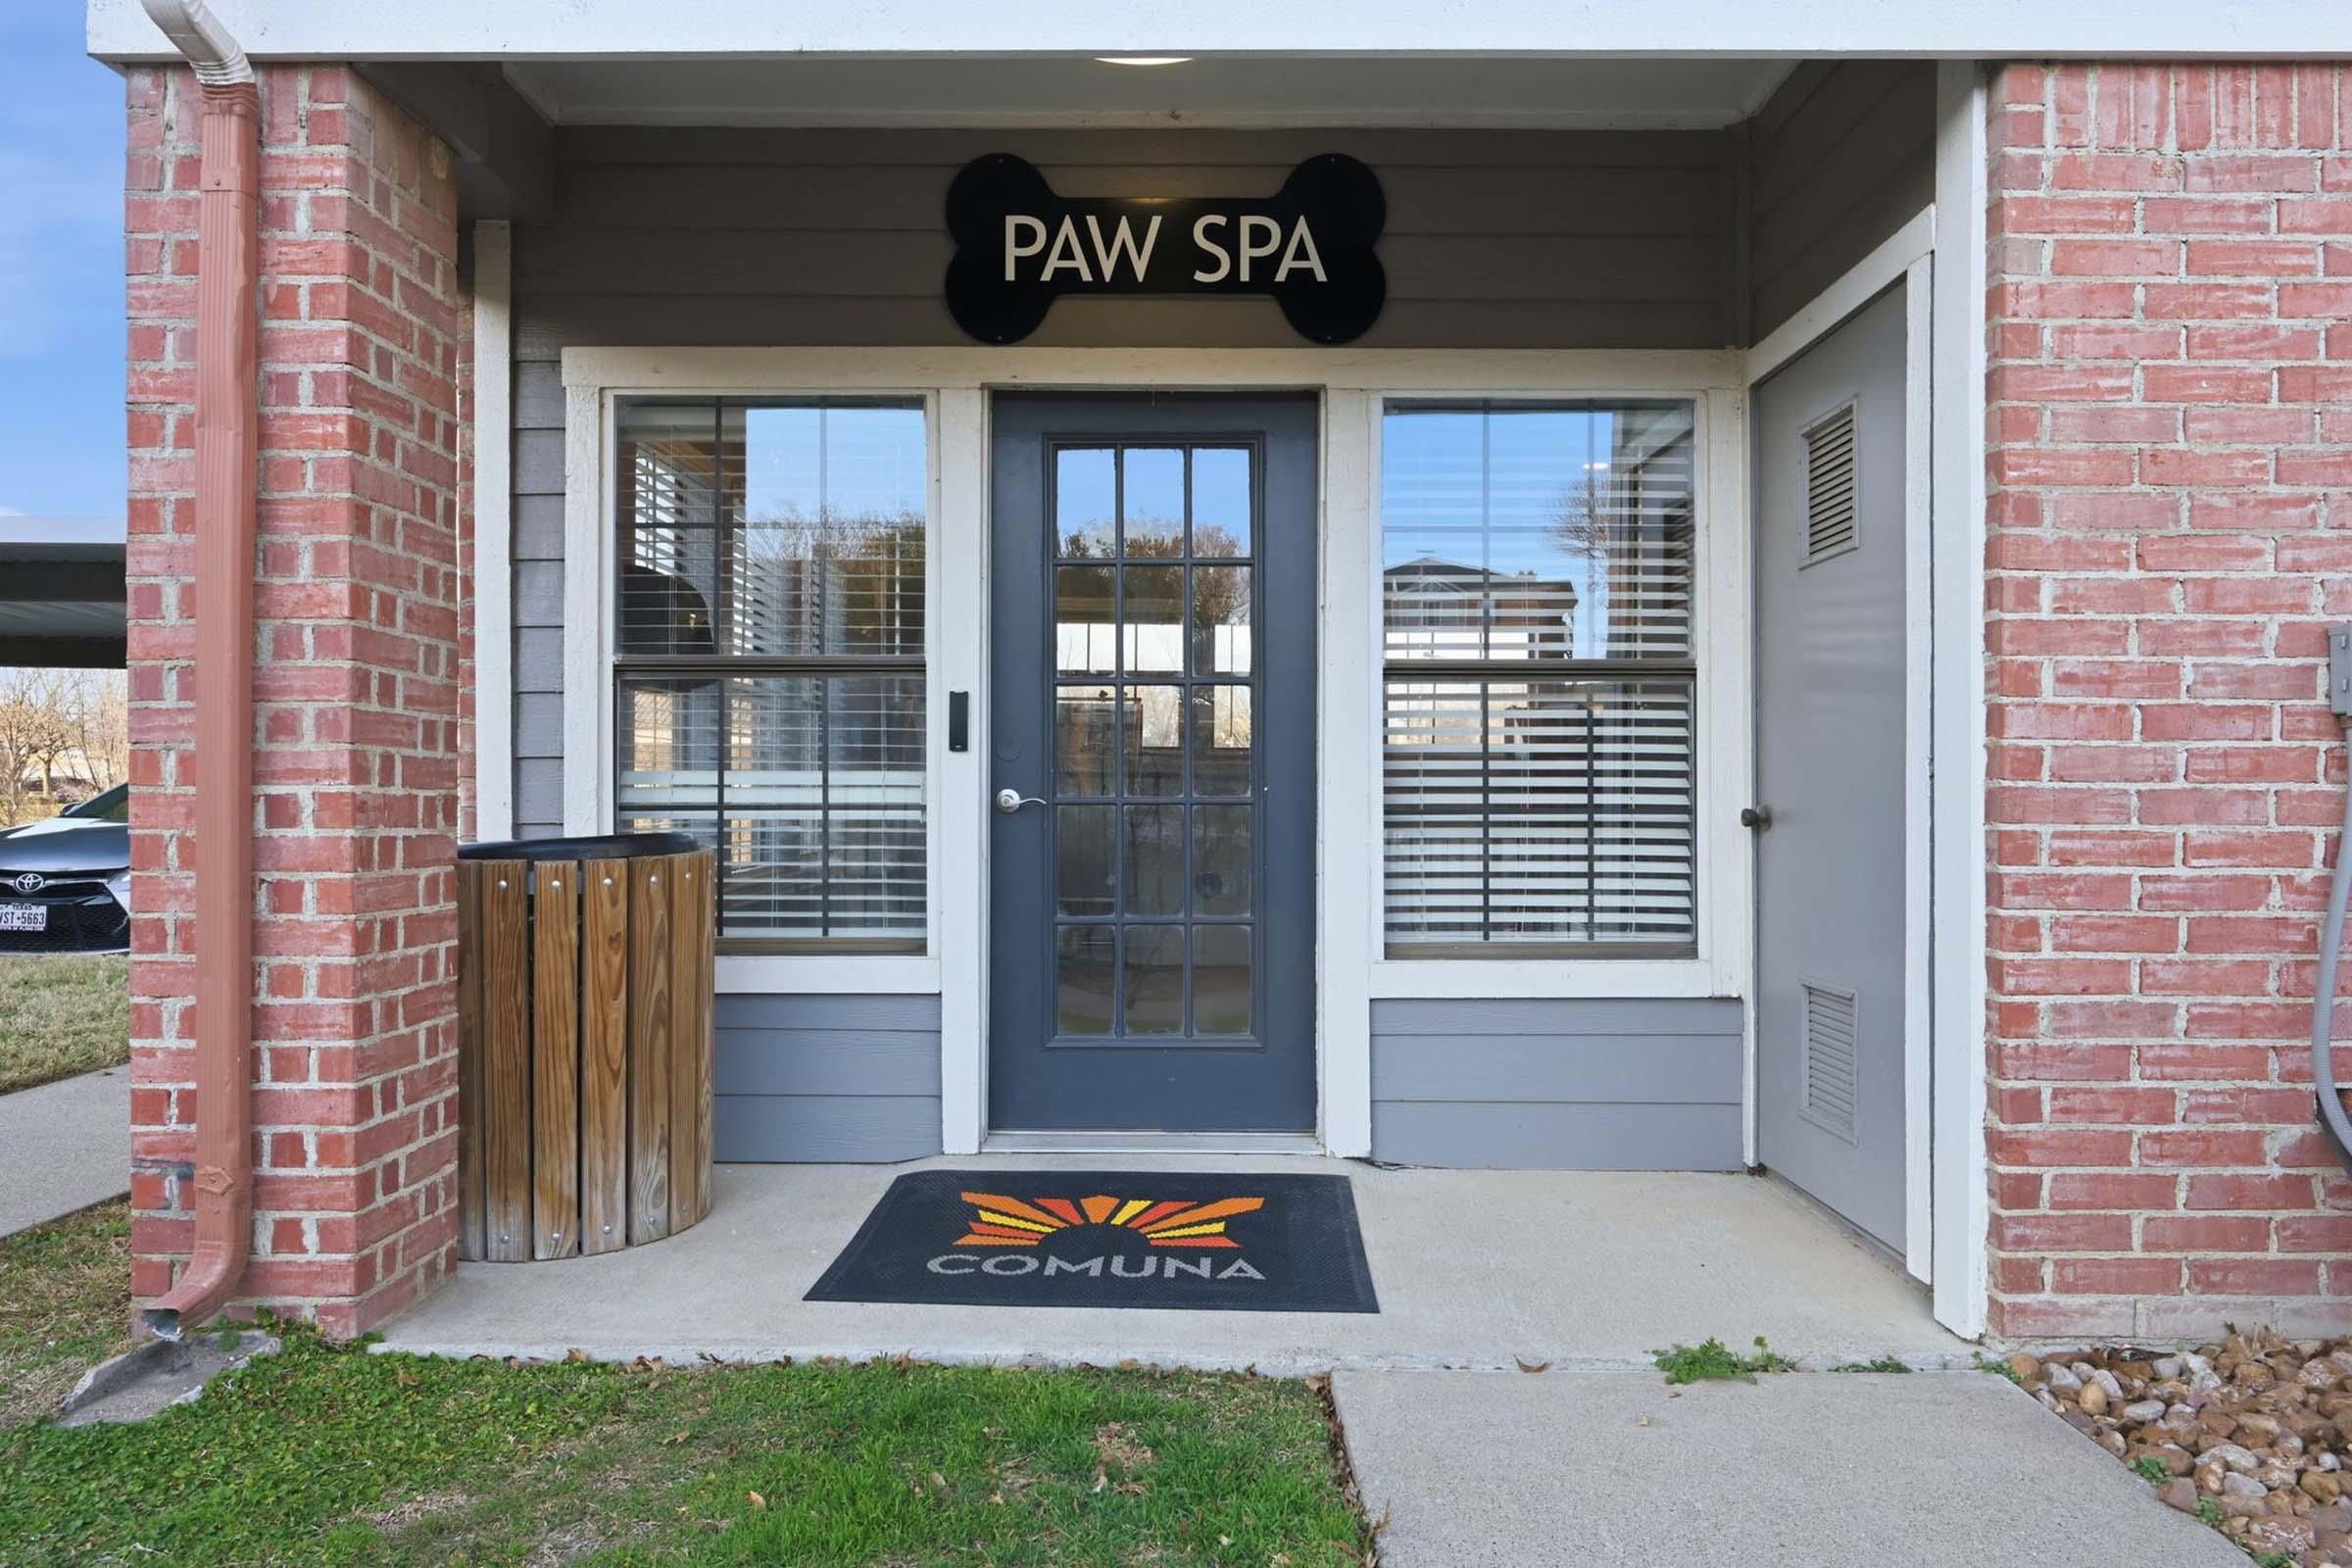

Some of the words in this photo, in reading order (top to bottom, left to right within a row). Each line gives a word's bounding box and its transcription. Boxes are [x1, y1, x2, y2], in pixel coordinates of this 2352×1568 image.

[1004, 214, 1163, 282] PAW
[1193, 214, 1328, 283] SPA
[926, 1254, 1266, 1280] COMUNA
